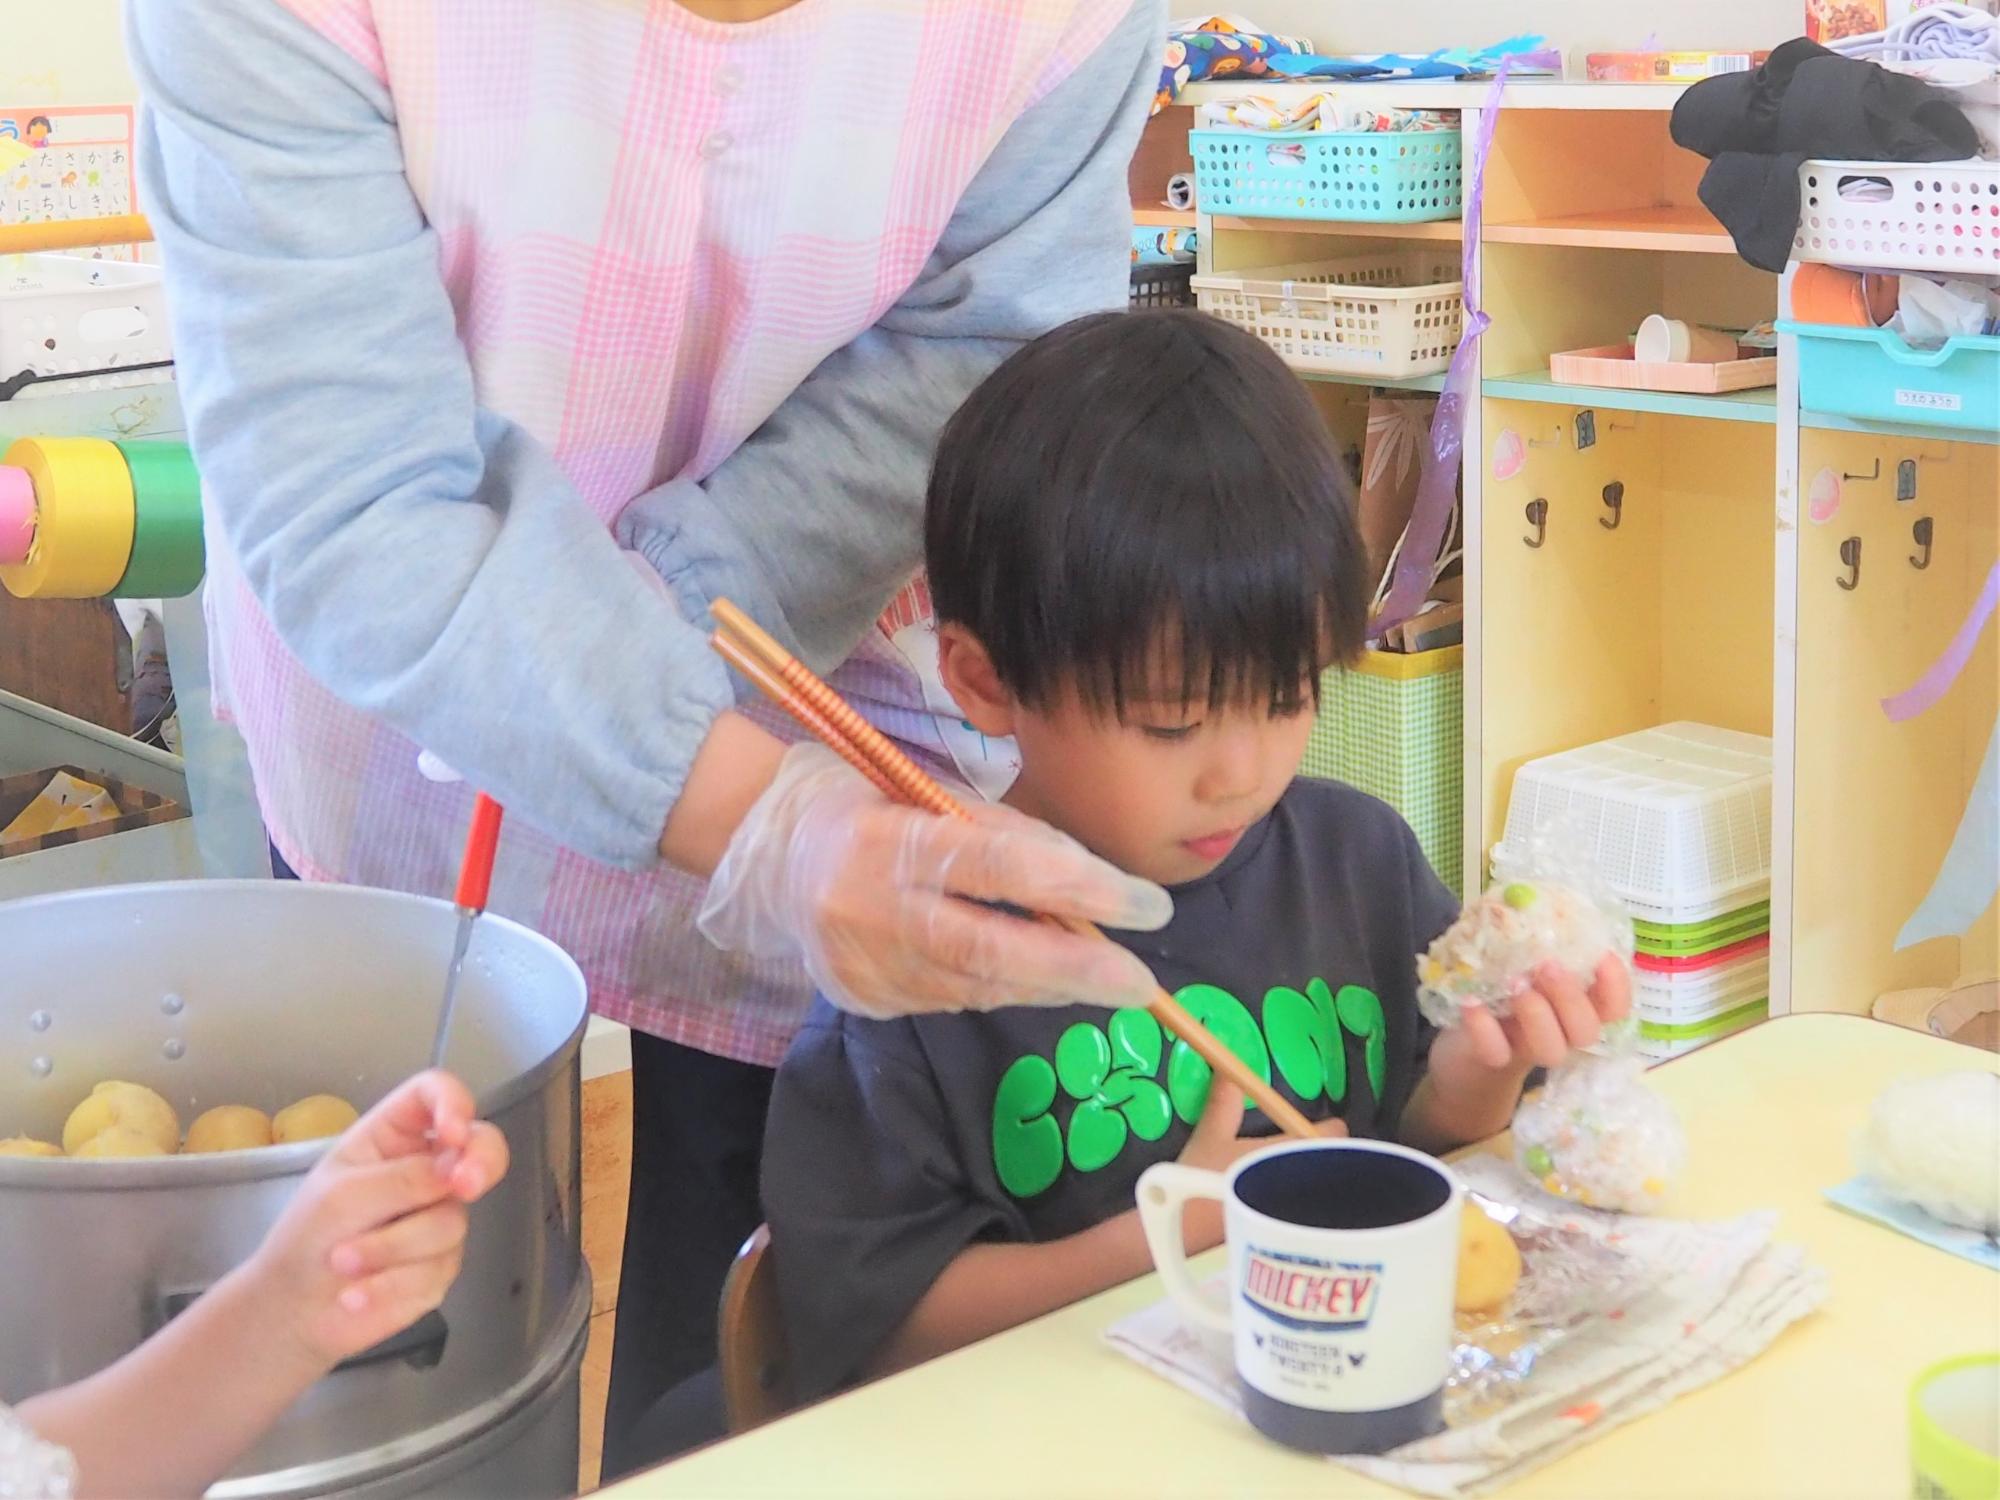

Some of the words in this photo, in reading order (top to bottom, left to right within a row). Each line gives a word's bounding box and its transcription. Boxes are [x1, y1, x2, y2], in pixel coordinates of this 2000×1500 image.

[113, 150, 125, 163] あ
[43, 195, 54, 210] ち
[1248, 1258, 1373, 1313] MICKEY
